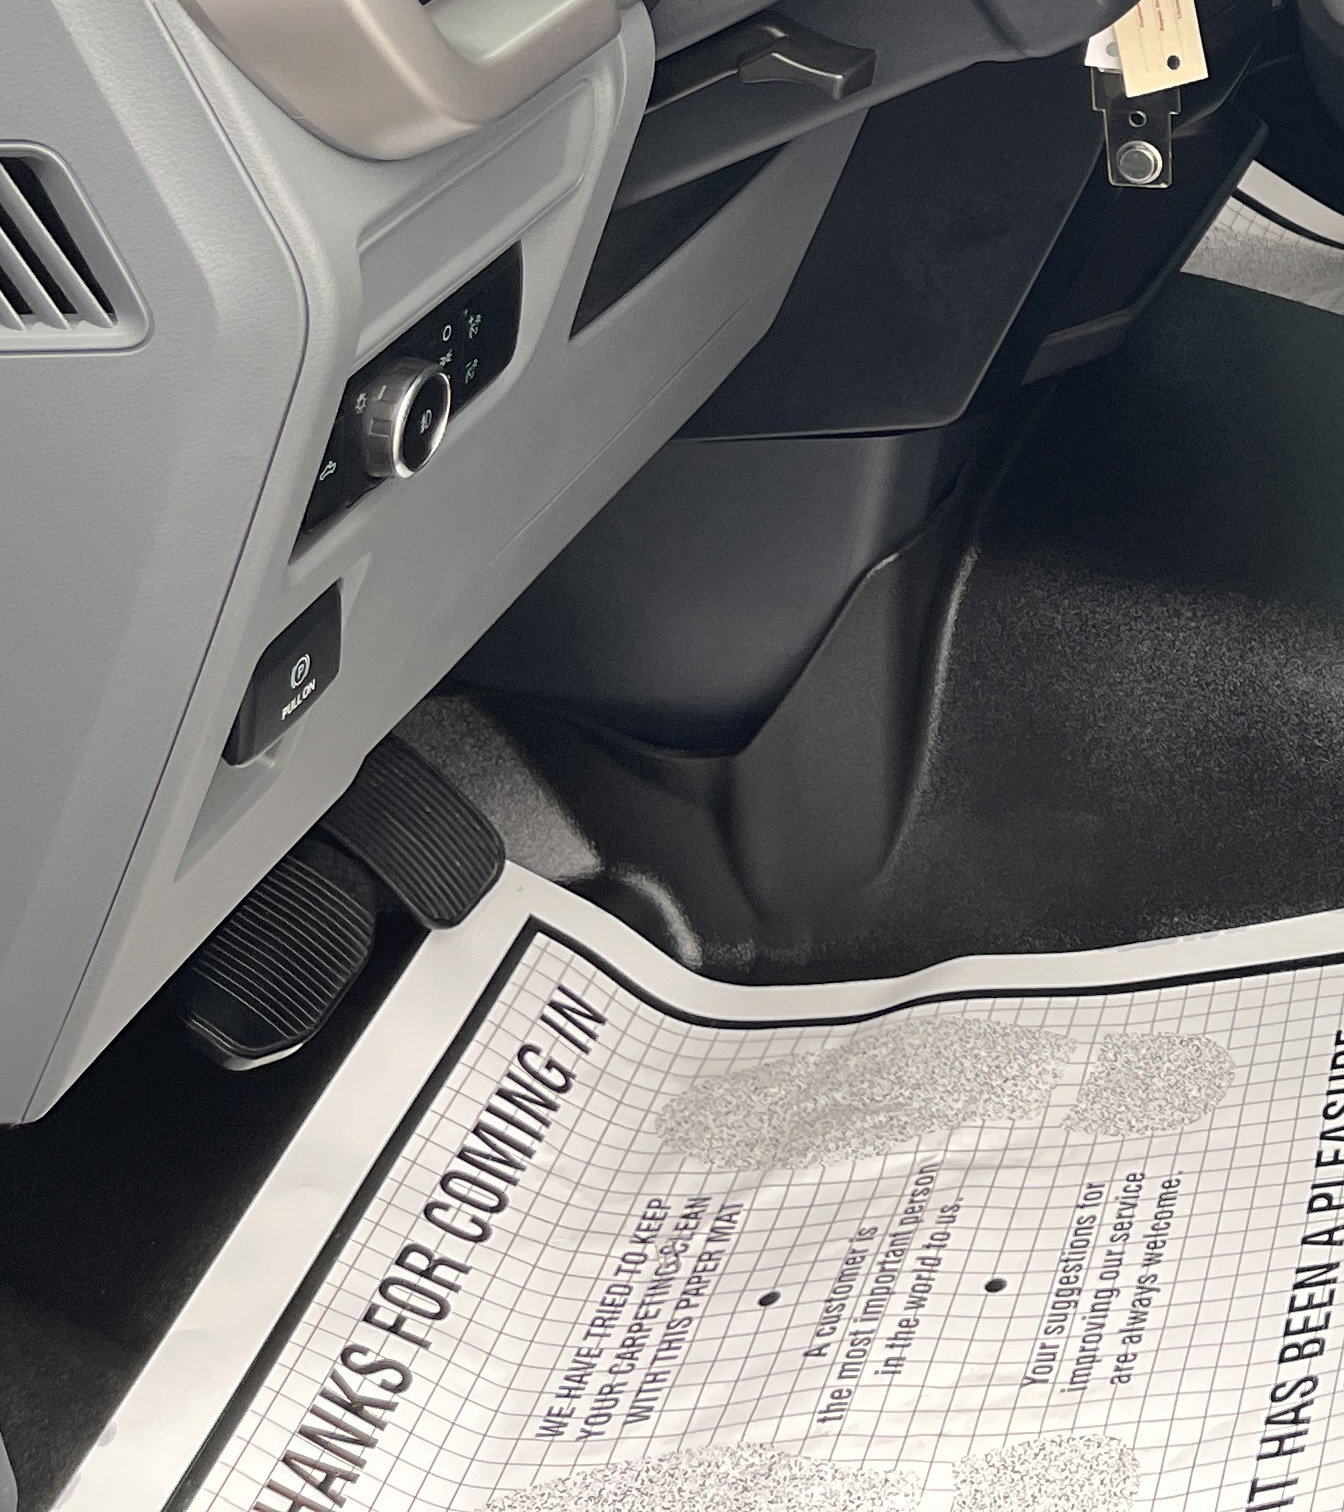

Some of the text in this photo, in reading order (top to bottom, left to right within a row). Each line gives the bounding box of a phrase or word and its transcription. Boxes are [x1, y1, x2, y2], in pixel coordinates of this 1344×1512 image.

[281, 678, 316, 721] PULL ON
[252, 983, 608, 1512] HANKS FOR COMING IN
[535, 1197, 671, 1438] WE HAVE TRIED TO KEEP
[623, 1201, 744, 1426] WITH THIS PAPER MAT
[802, 1226, 879, 1358] A customer is
[816, 1162, 939, 1424] the most important person
[873, 1196, 964, 1376] in the world to us.
[1020, 1181, 1106, 1388] Your suggestions for
[1060, 1171, 1145, 1393] improving our service
[1110, 1170, 1183, 1385] are always welcome.
[1277, 1261, 1341, 1365] BEEN
[575, 1381, 628, 1442] YOUR
[1244, 1477, 1299, 1512] IT
[1256, 1374, 1319, 1461] HAS
